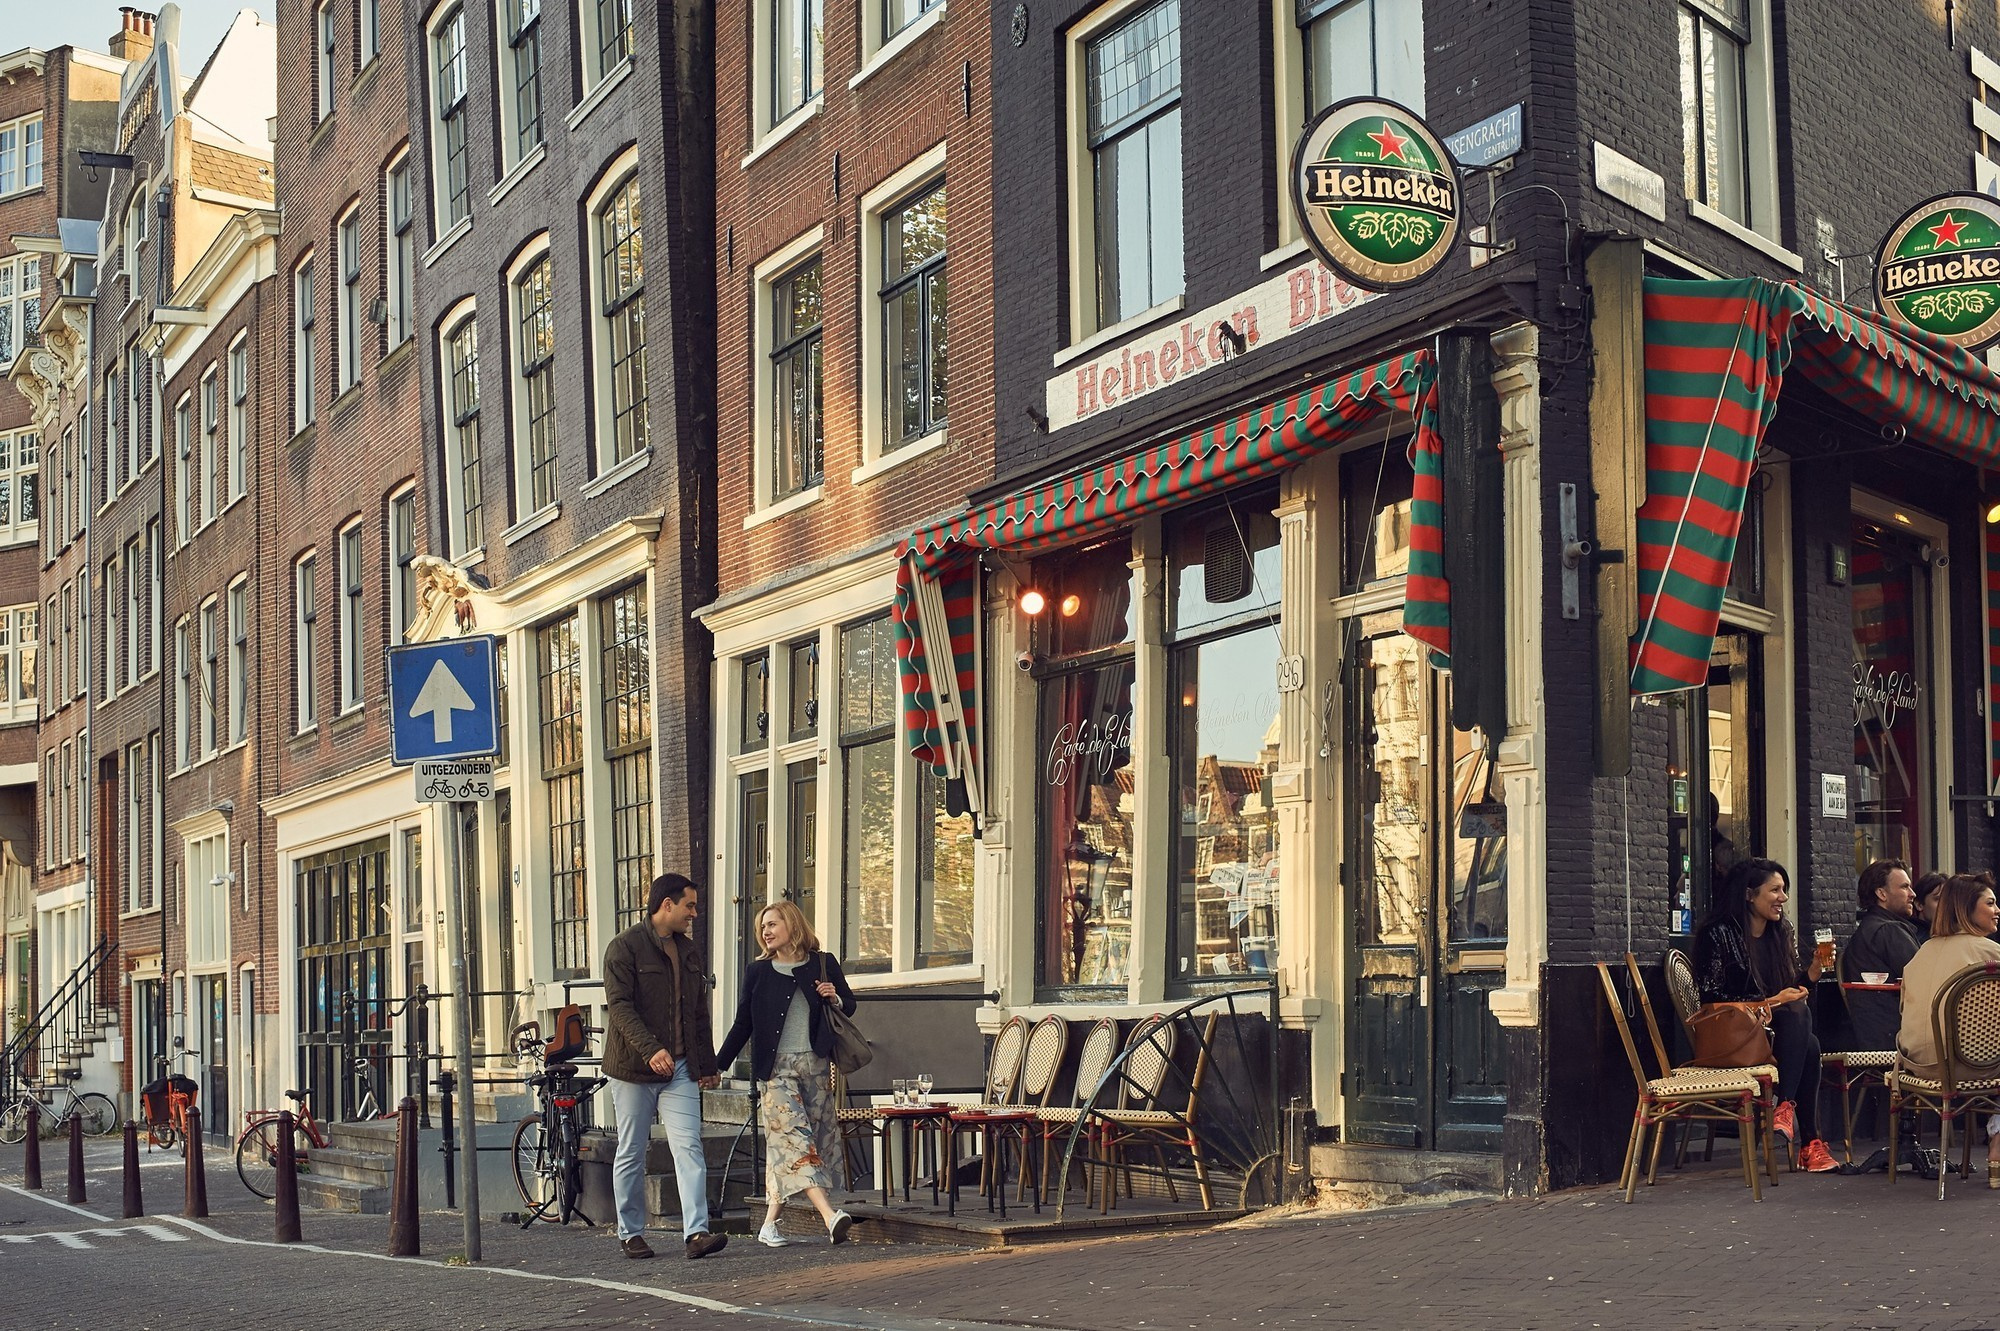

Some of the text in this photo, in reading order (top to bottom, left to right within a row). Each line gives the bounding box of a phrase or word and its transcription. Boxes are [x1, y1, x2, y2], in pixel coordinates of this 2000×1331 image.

[1484, 135, 1518, 159] CENTRUM
[1315, 169, 1452, 211] Heineken
[1325, 235, 1443, 278] PREMIUM QUALITY
[1076, 263, 1386, 418] Heineken Bie
[1279, 659, 1299, 688] 296
[421, 763, 491, 775] UITGEZONDERD
